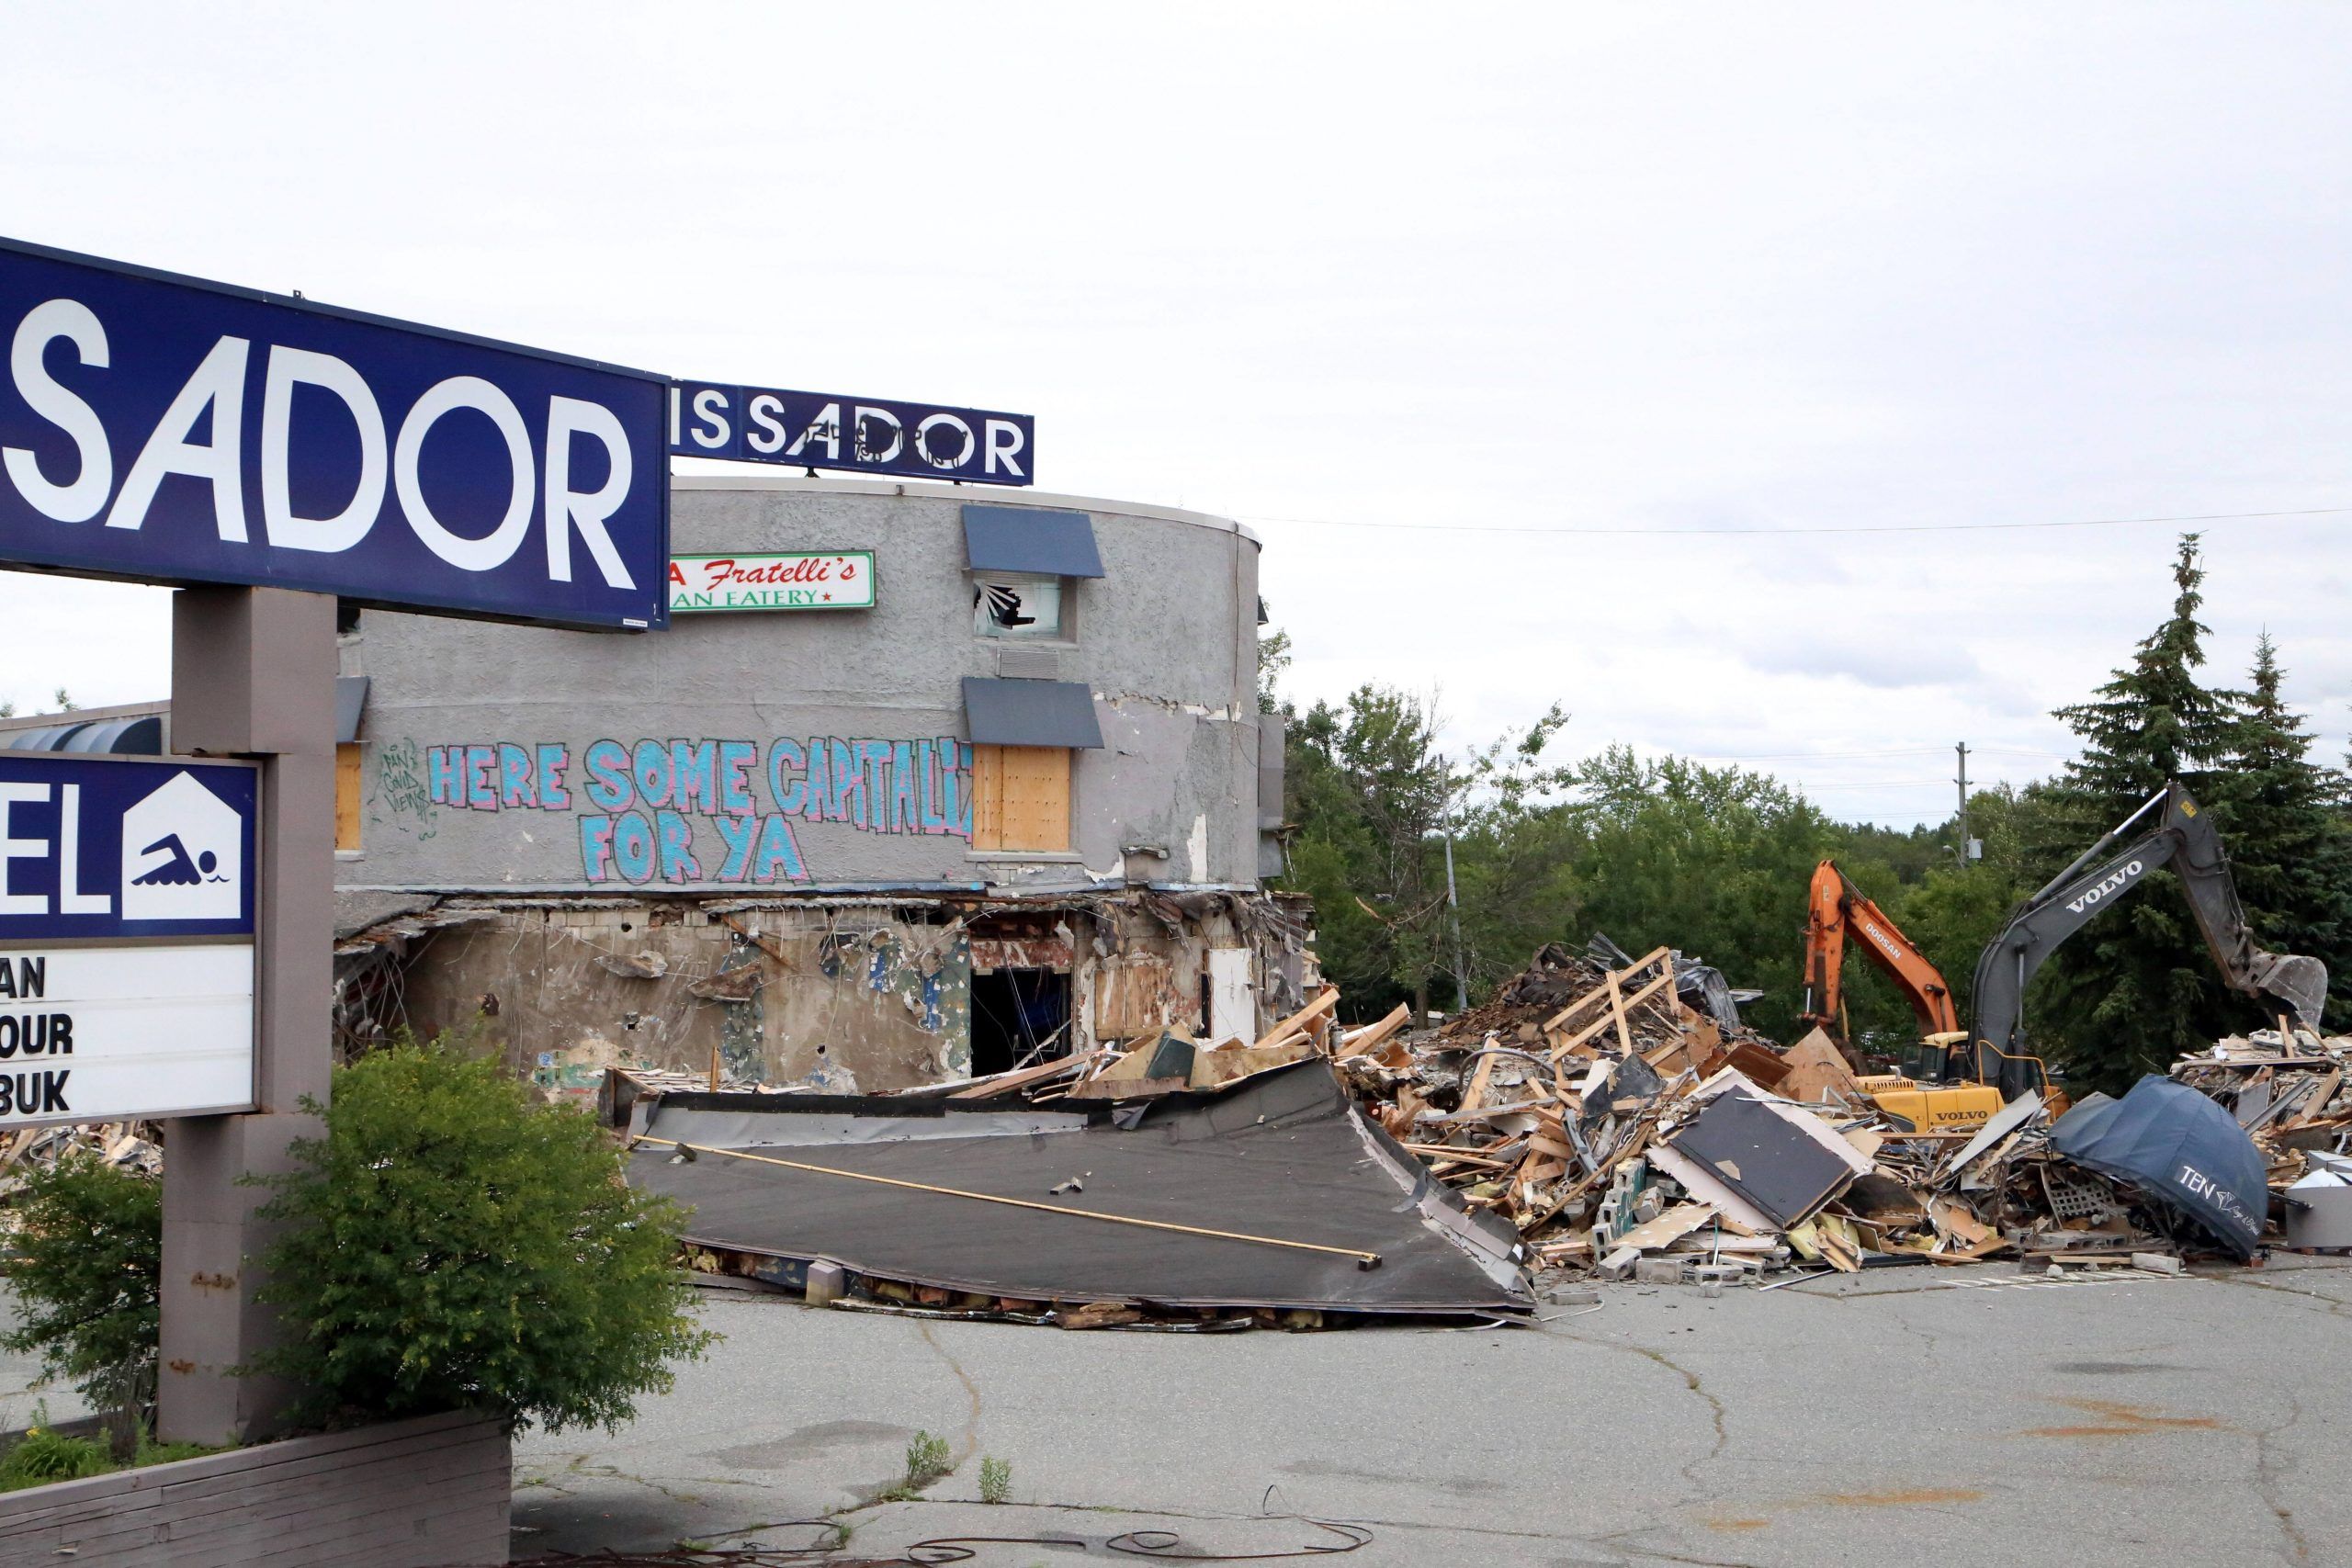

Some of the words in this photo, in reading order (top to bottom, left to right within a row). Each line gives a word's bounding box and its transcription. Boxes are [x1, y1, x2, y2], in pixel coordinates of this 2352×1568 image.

[2, 299, 637, 590] SADOR
[704, 557, 856, 591] Fratelli's
[673, 592, 713, 606] AN
[727, 590, 818, 606] EATERY
[426, 742, 571, 813] HERE
[583, 738, 758, 817] SOME
[0, 783, 111, 914] EL
[579, 810, 702, 886] FOR
[711, 813, 816, 886] YA
[2065, 860, 2143, 913] VOLVO
[1865, 922, 1901, 959] DOOSAN
[0, 1013, 73, 1058] OUR
[1936, 1111, 1987, 1121] VOLVO
[2180, 1166, 2216, 1200] TEN
